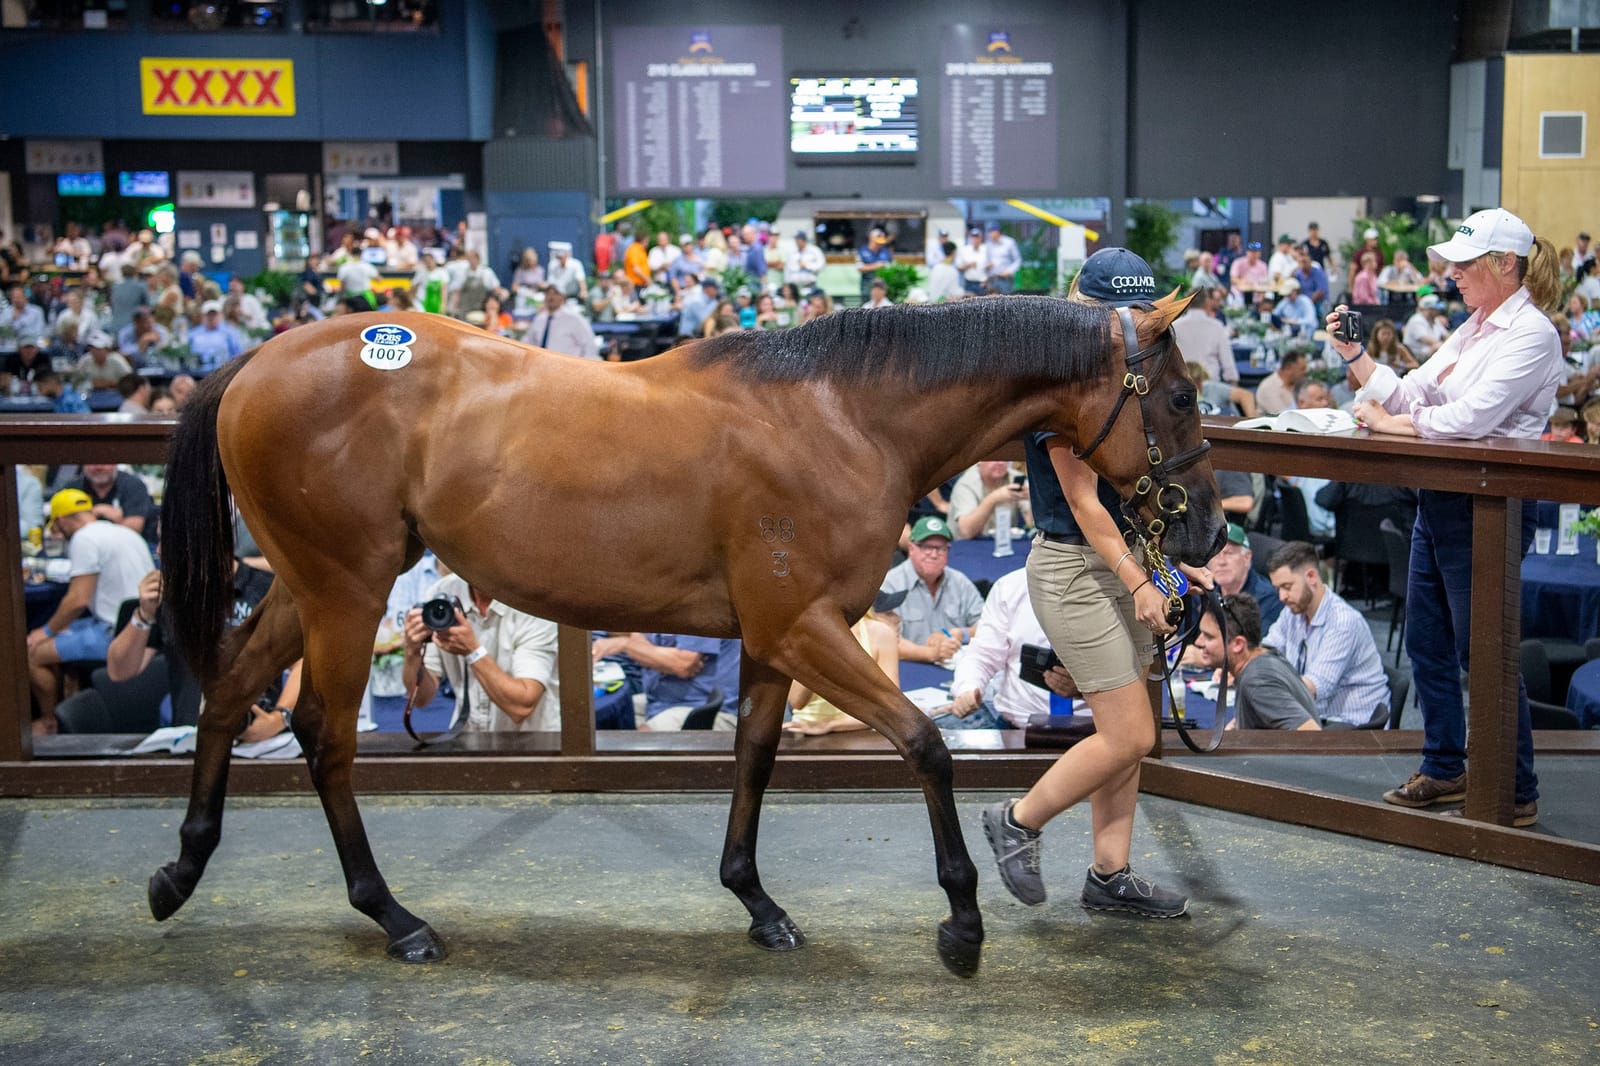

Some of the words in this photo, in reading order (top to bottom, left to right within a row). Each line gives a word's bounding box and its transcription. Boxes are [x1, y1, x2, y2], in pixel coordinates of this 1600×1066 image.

[152, 67, 283, 107] XXXX
[375, 333, 402, 342] BOBS
[368, 347, 406, 362] 1007
[772, 551, 791, 577] 3
